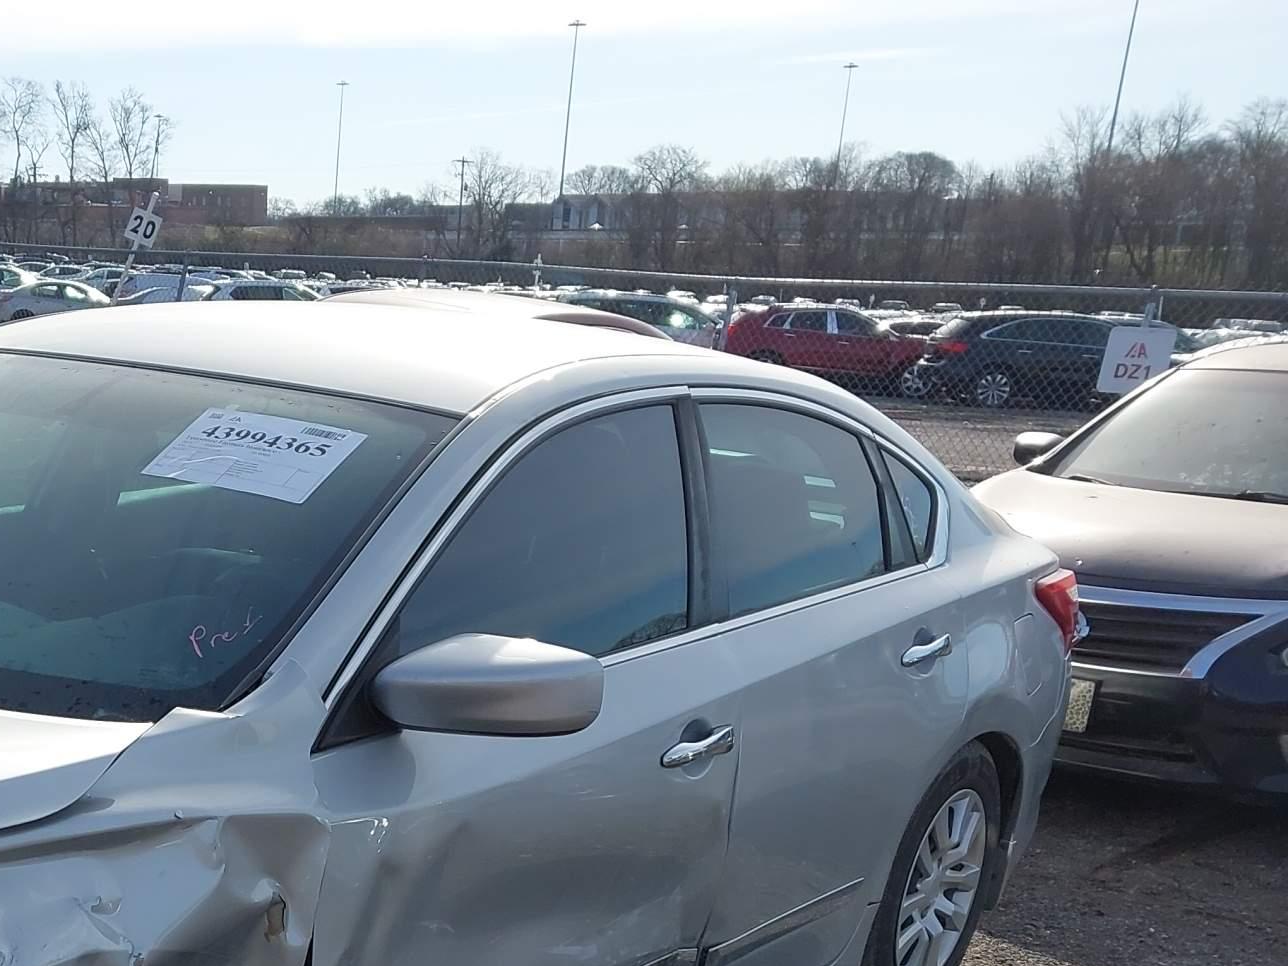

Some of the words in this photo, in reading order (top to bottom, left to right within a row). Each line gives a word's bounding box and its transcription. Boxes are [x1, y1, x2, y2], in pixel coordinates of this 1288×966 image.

[129, 214, 156, 239] 20
[1113, 363, 1152, 380] DZ1
[201, 424, 334, 458] 43994365
